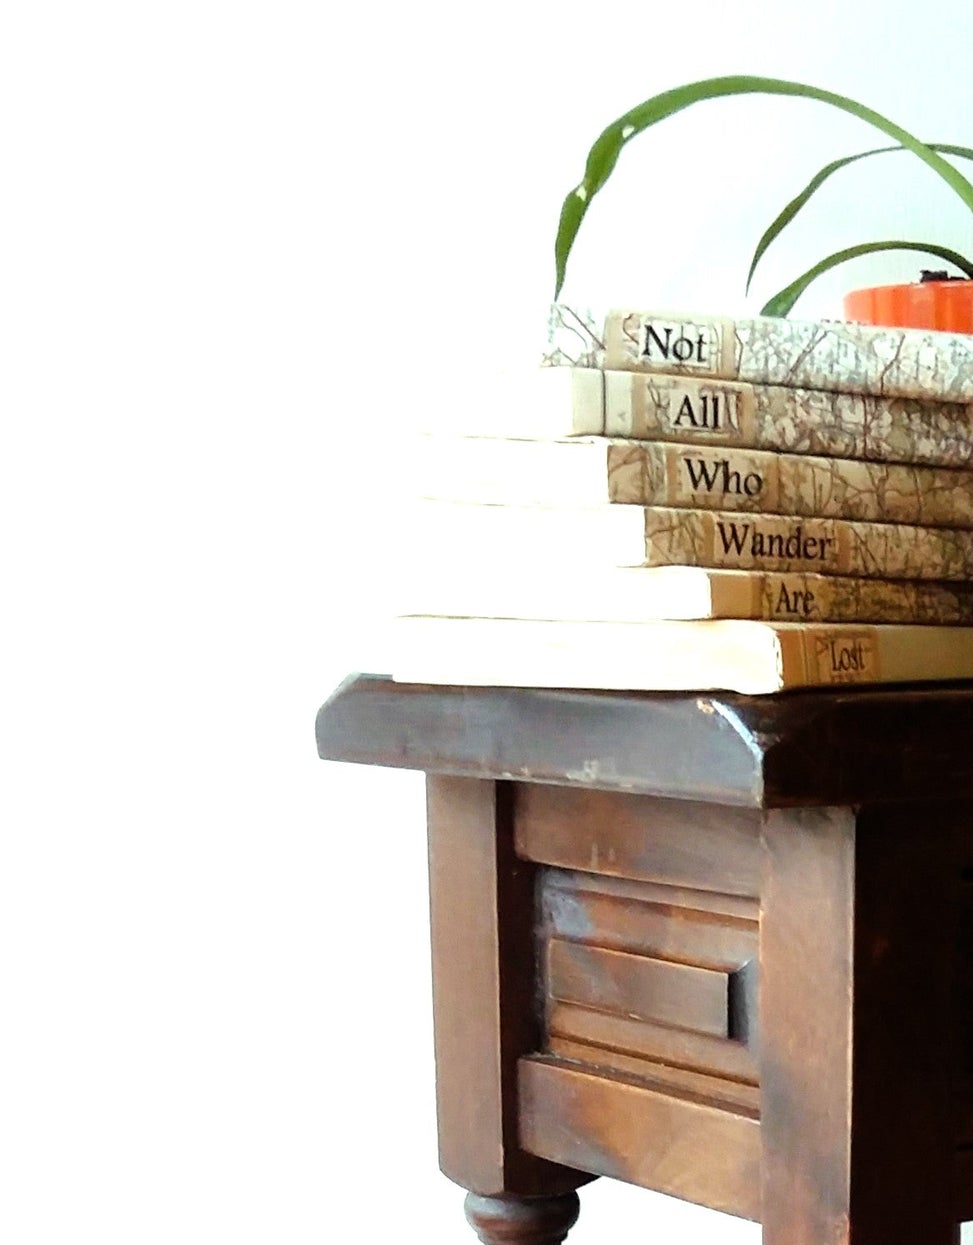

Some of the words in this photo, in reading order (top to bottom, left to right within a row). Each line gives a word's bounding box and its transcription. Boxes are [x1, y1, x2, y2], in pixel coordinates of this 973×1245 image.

[641, 324, 707, 362] Not
[673, 394, 721, 431] All
[684, 458, 763, 495] Who
[717, 521, 833, 561] Wander
[775, 582, 815, 615] Are
[830, 639, 866, 671] Lost
